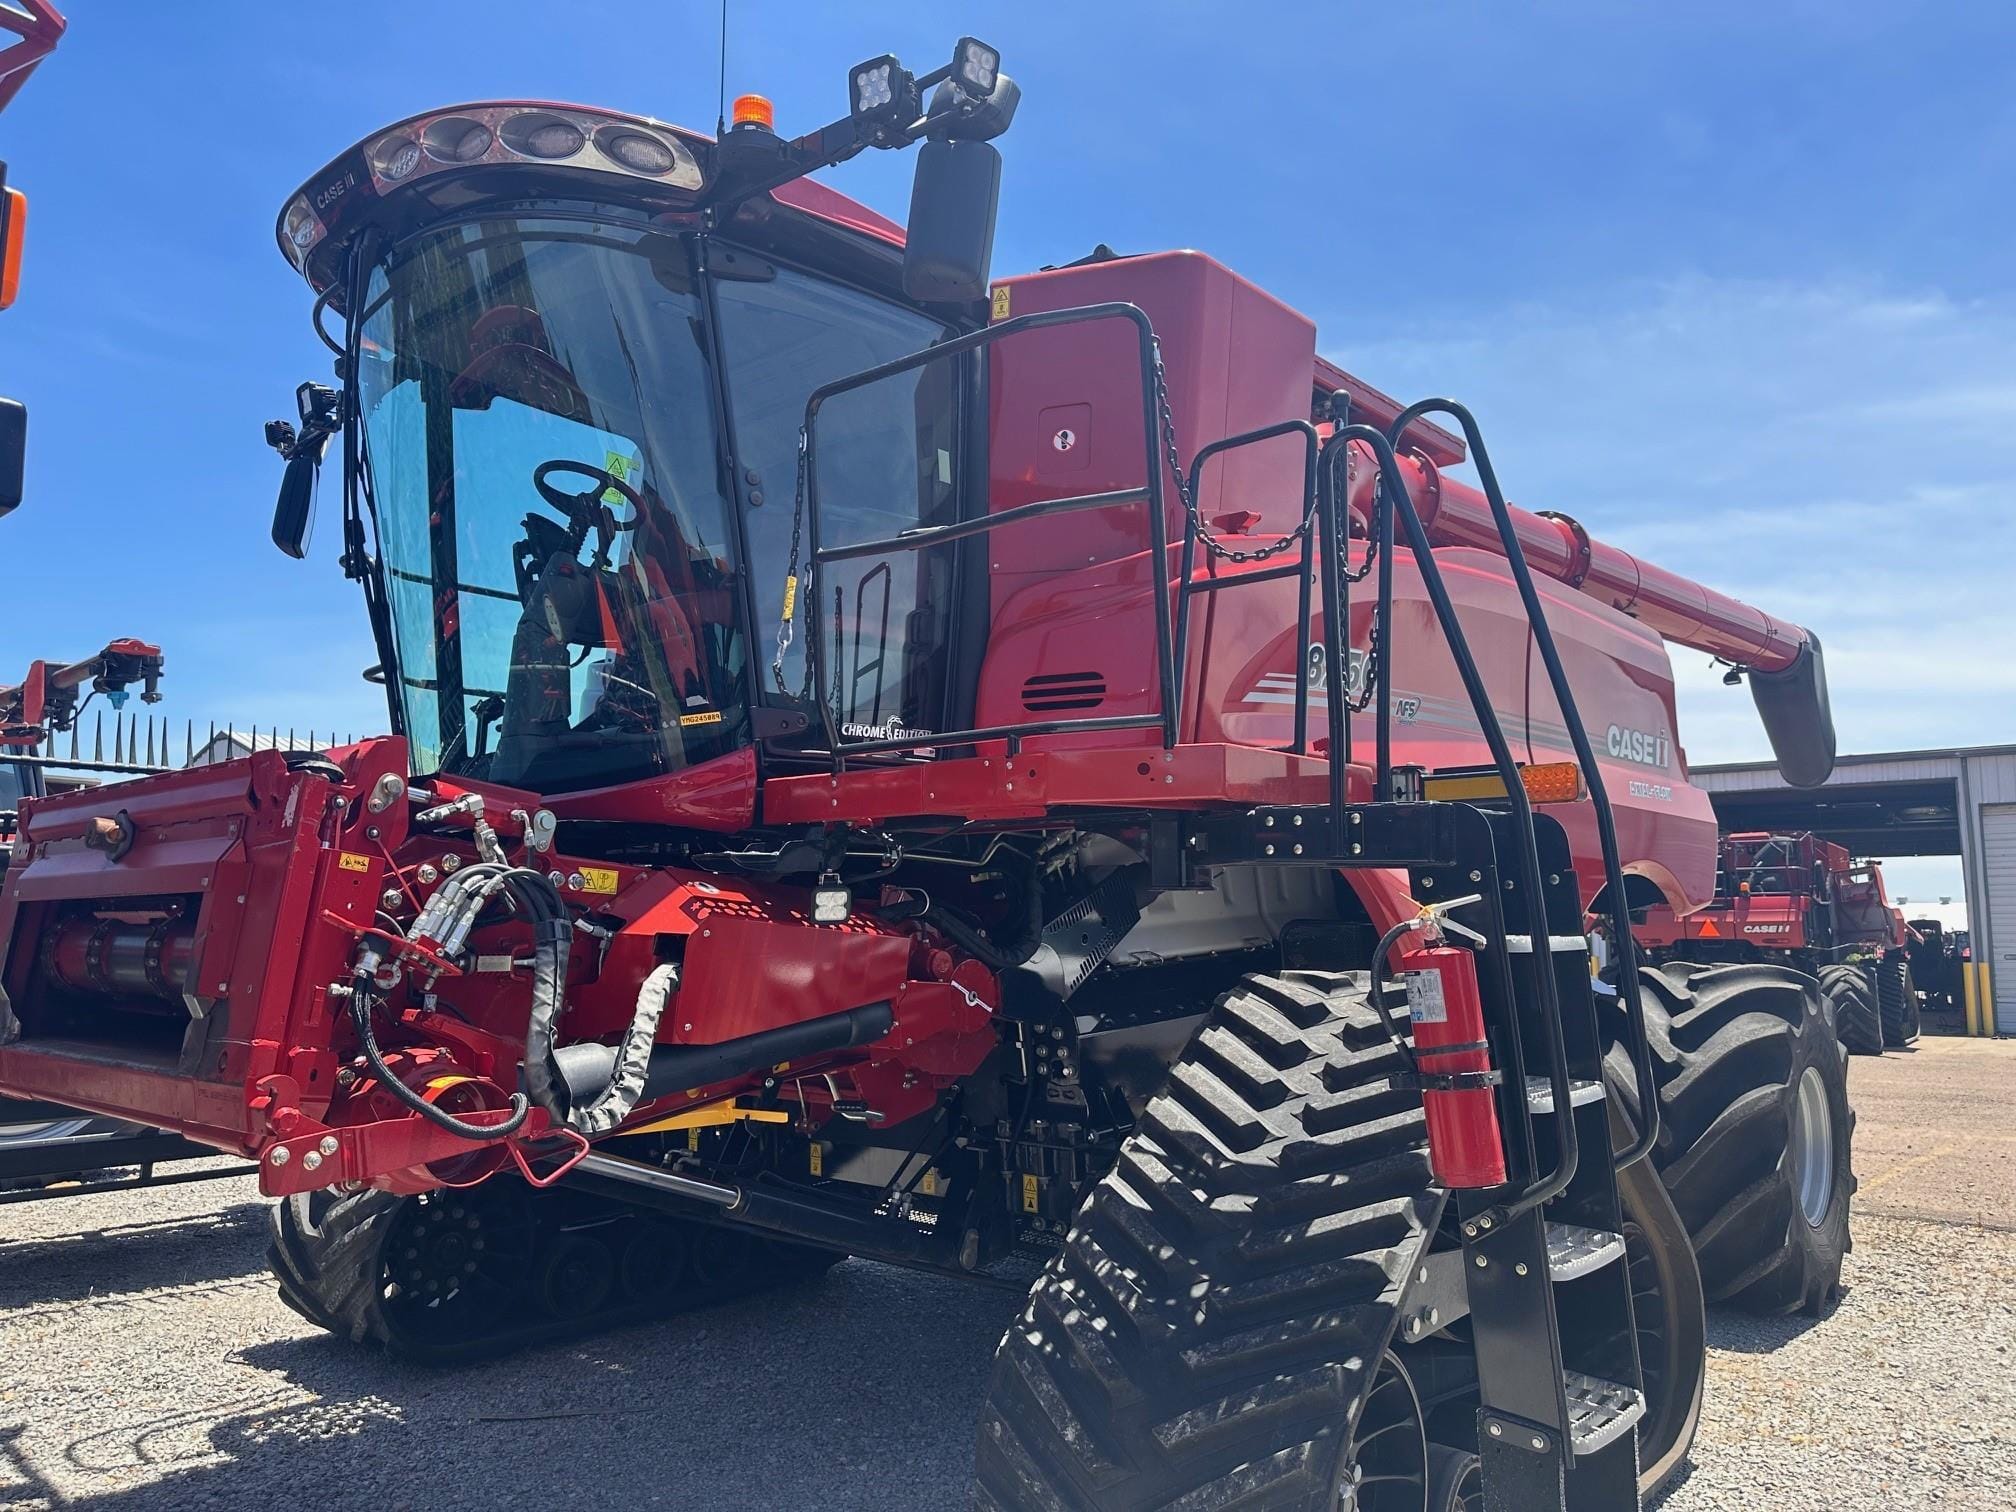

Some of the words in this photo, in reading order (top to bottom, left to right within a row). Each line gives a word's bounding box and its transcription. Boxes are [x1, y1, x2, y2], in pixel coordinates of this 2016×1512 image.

[317, 180, 345, 209] CASE
[1395, 699, 1417, 718] AFS
[841, 724, 886, 739] CHROME
[1607, 725, 1654, 764] CASE
[1743, 925, 1778, 933] CASE
